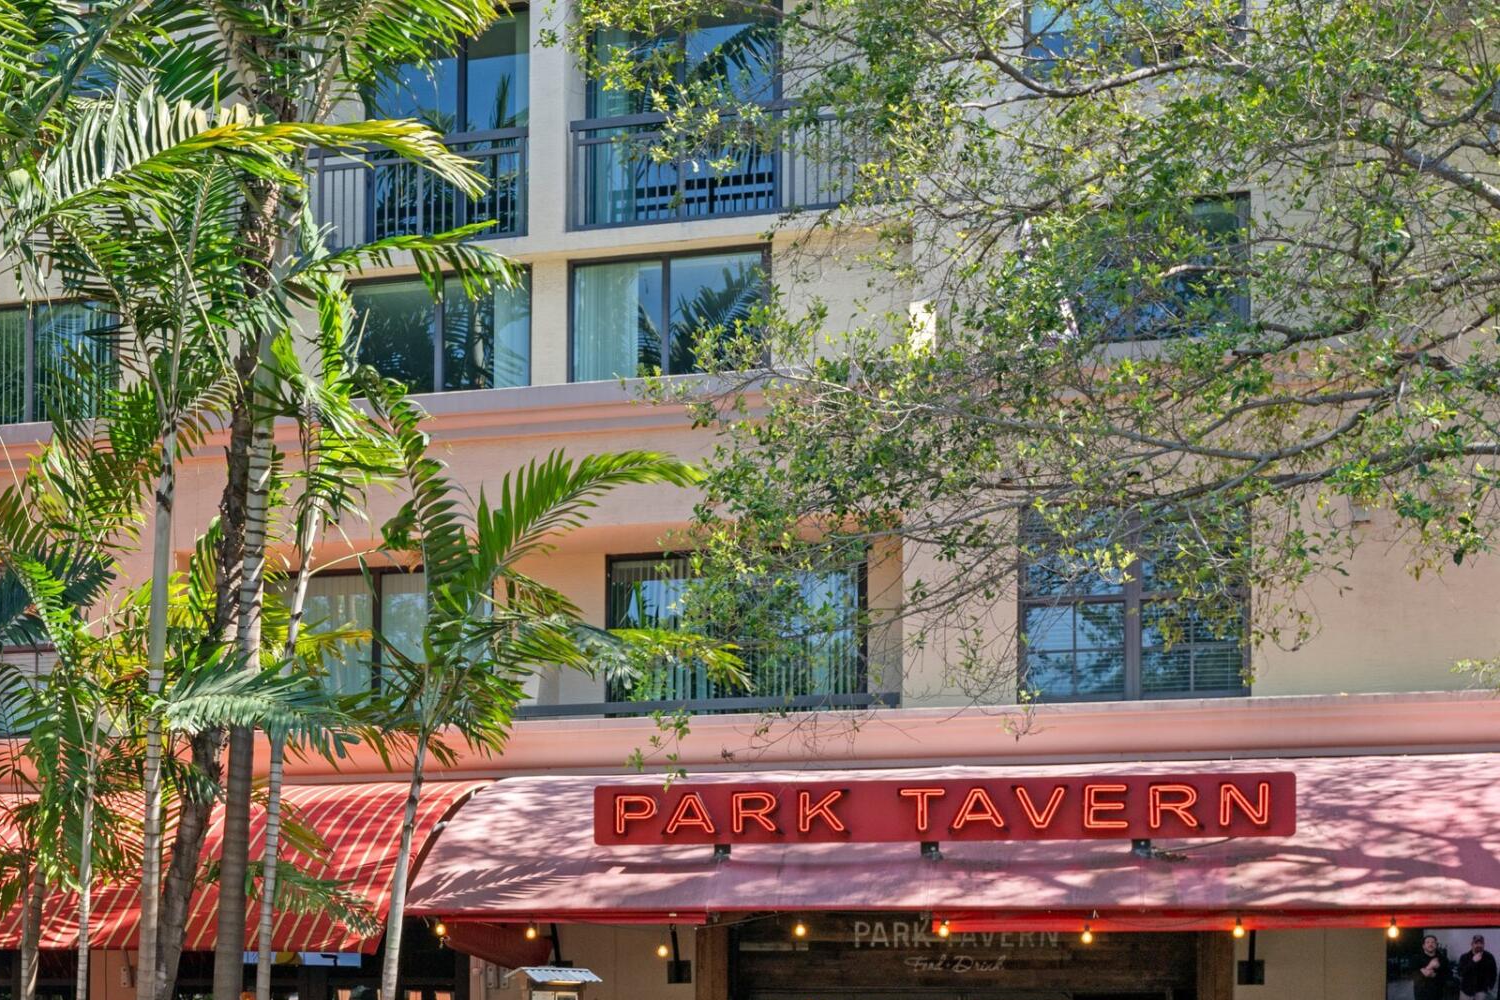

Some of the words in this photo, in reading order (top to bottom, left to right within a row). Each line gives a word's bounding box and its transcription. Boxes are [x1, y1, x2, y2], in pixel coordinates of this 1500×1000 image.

[613, 788, 848, 836] PARK
[897, 780, 1269, 830] TAVERN
[854, 920, 931, 948] PARK
